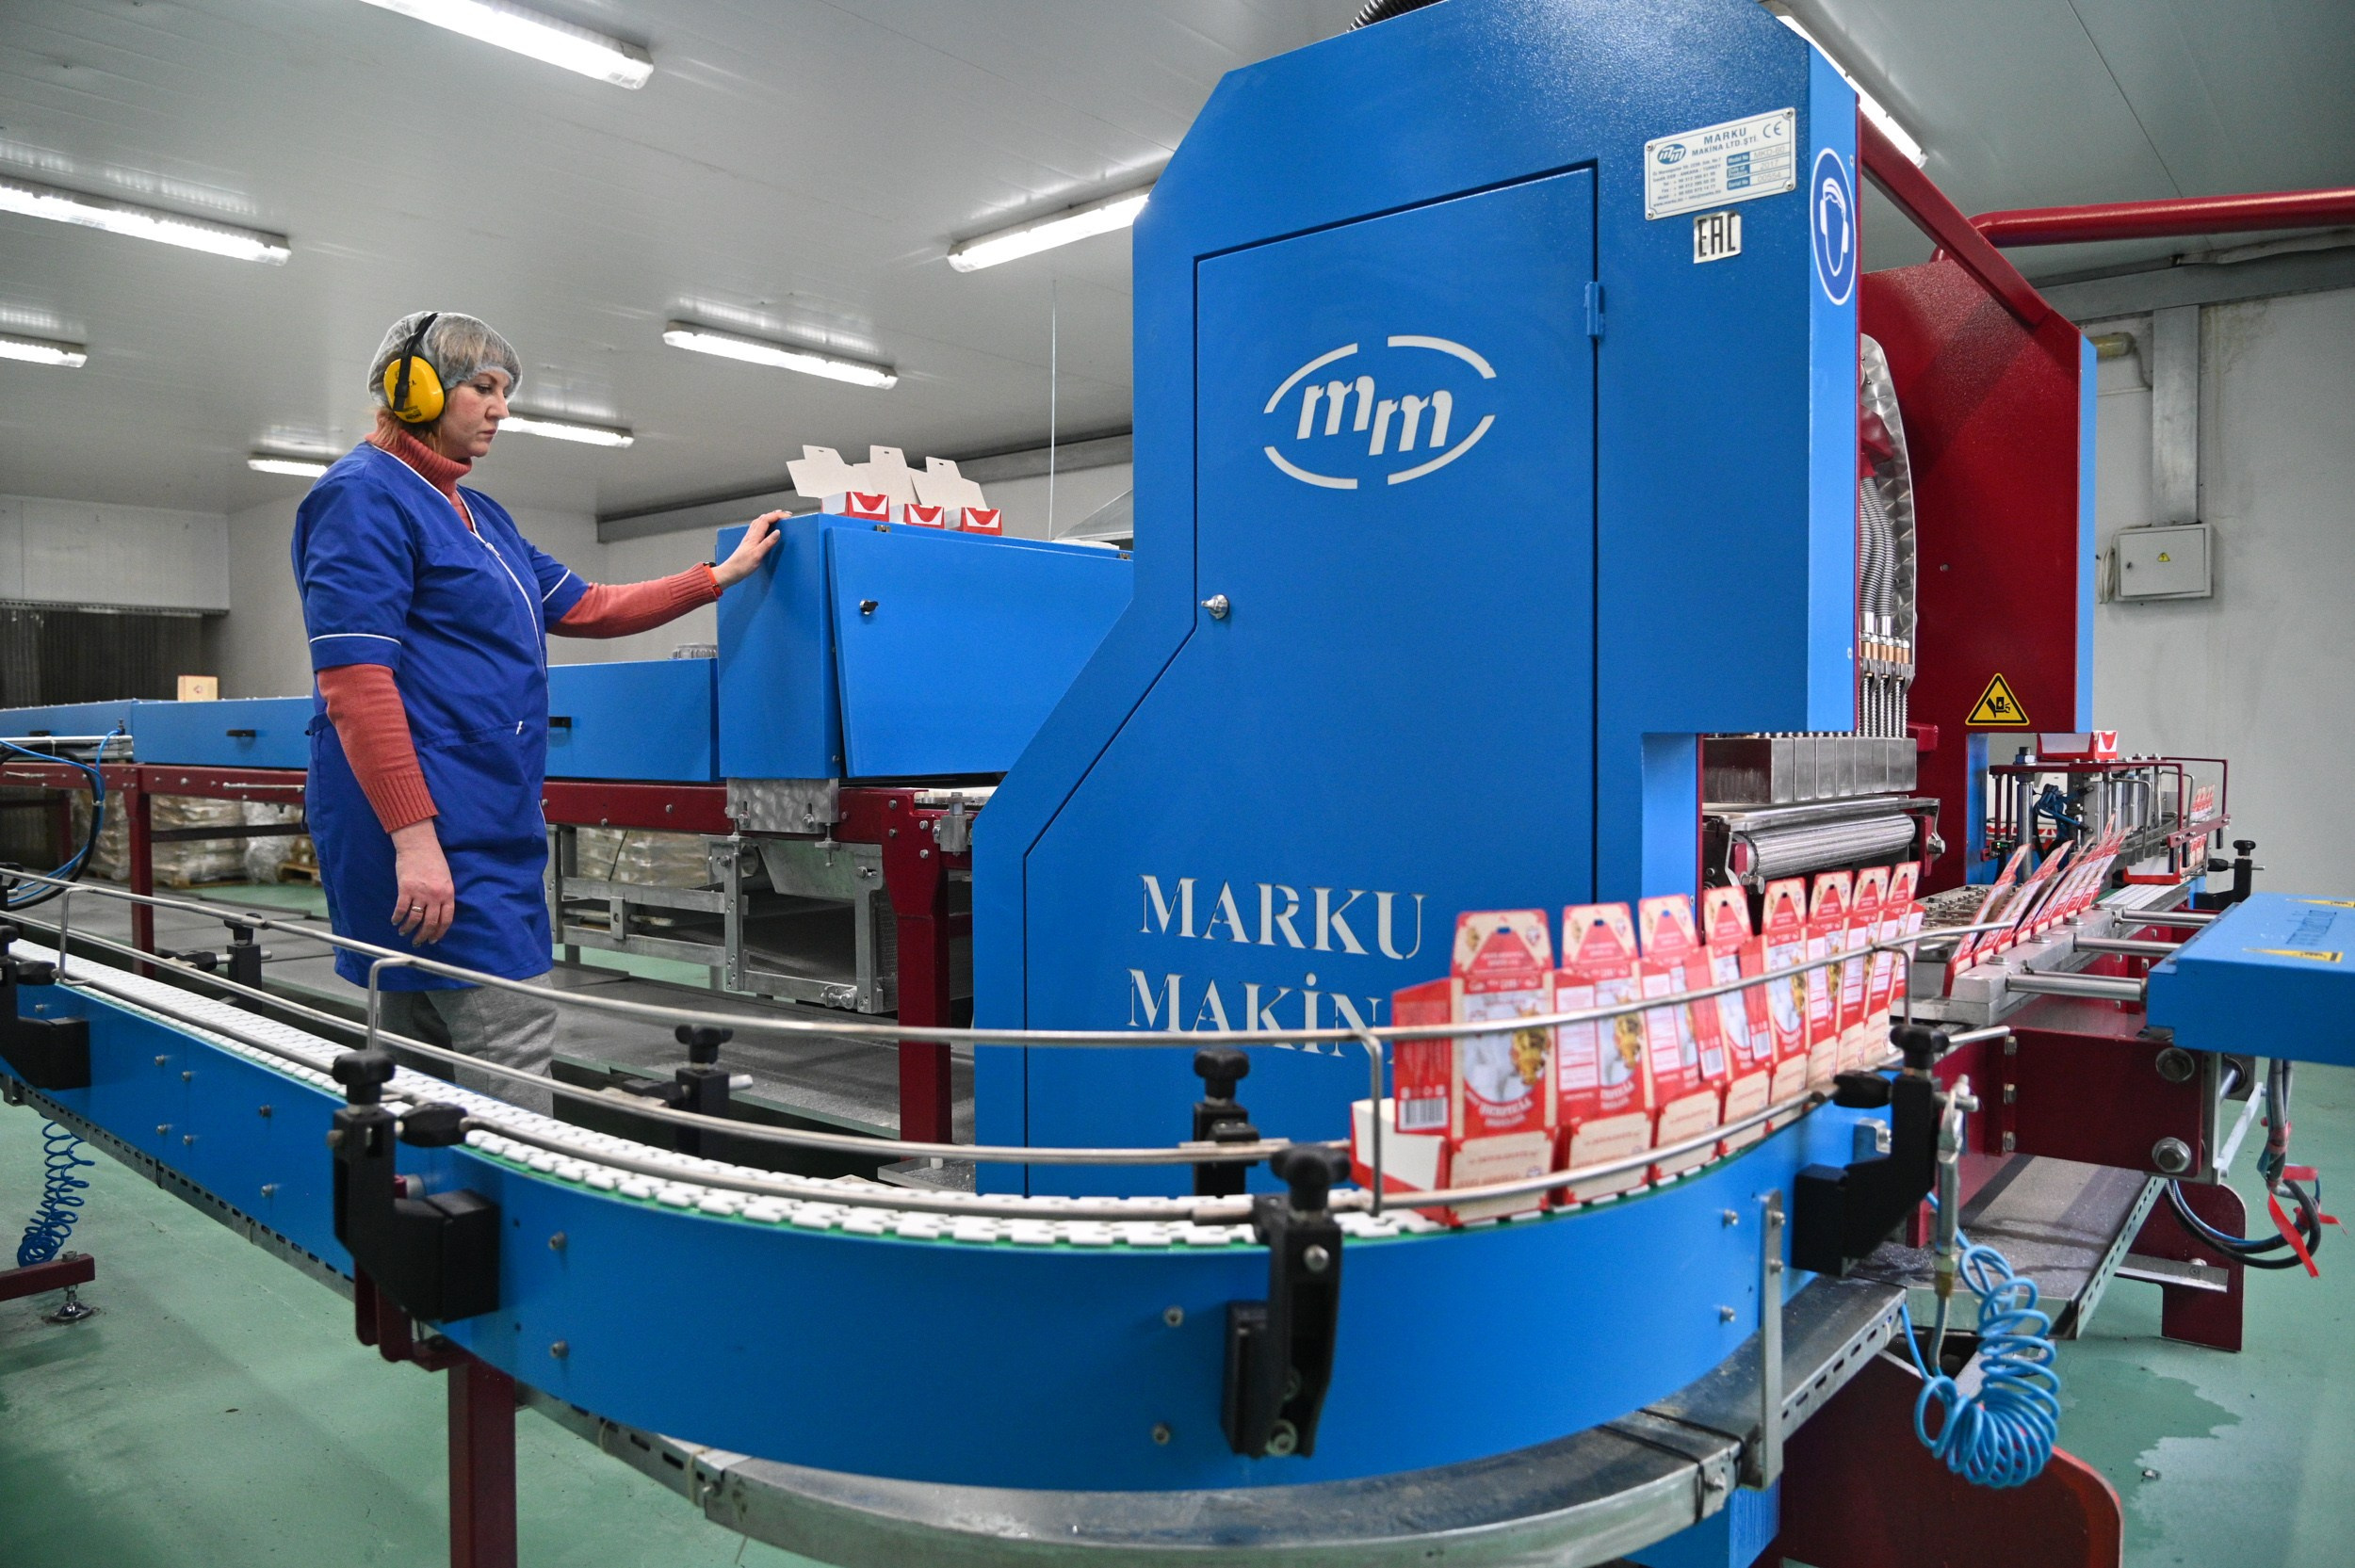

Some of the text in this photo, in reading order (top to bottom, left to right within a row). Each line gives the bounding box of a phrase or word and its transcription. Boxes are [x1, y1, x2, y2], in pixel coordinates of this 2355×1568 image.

[1691, 143, 1724, 156] MAKİNA
[1703, 127, 1747, 145] MARKU
[1697, 212, 1736, 258] EAC
[1137, 873, 1429, 961] MARKU
[1126, 968, 1394, 1065] MAKİN
